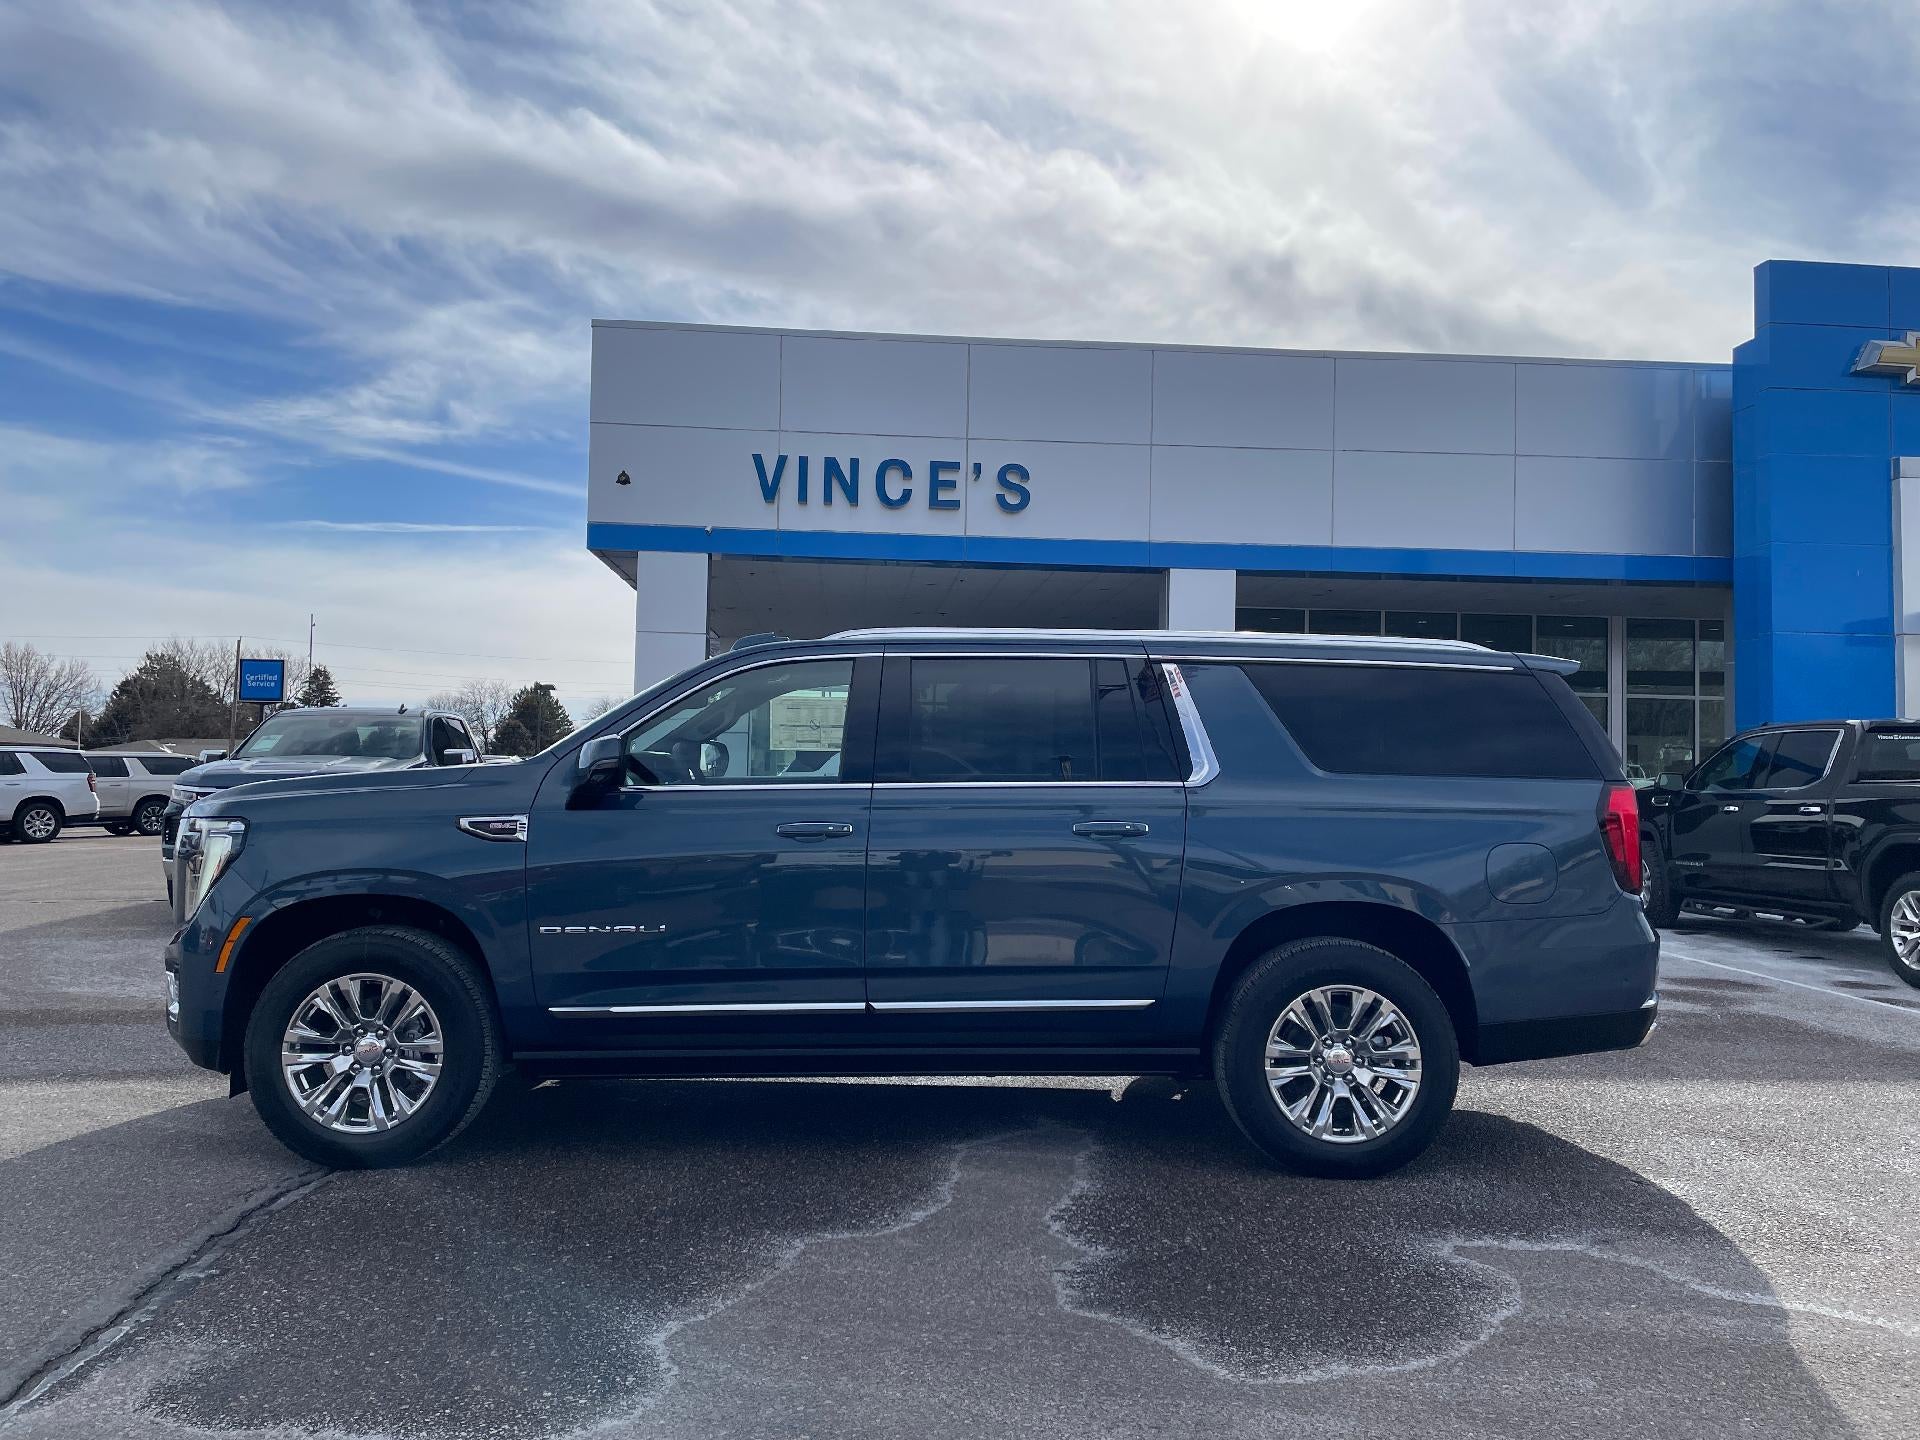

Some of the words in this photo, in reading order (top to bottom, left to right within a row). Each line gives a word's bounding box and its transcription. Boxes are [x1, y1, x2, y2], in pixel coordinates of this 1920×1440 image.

[751, 453, 1032, 513] VINCE'S
[245, 673, 278, 681] Certified
[247, 680, 276, 688] Service
[539, 924, 666, 934] DENALI
